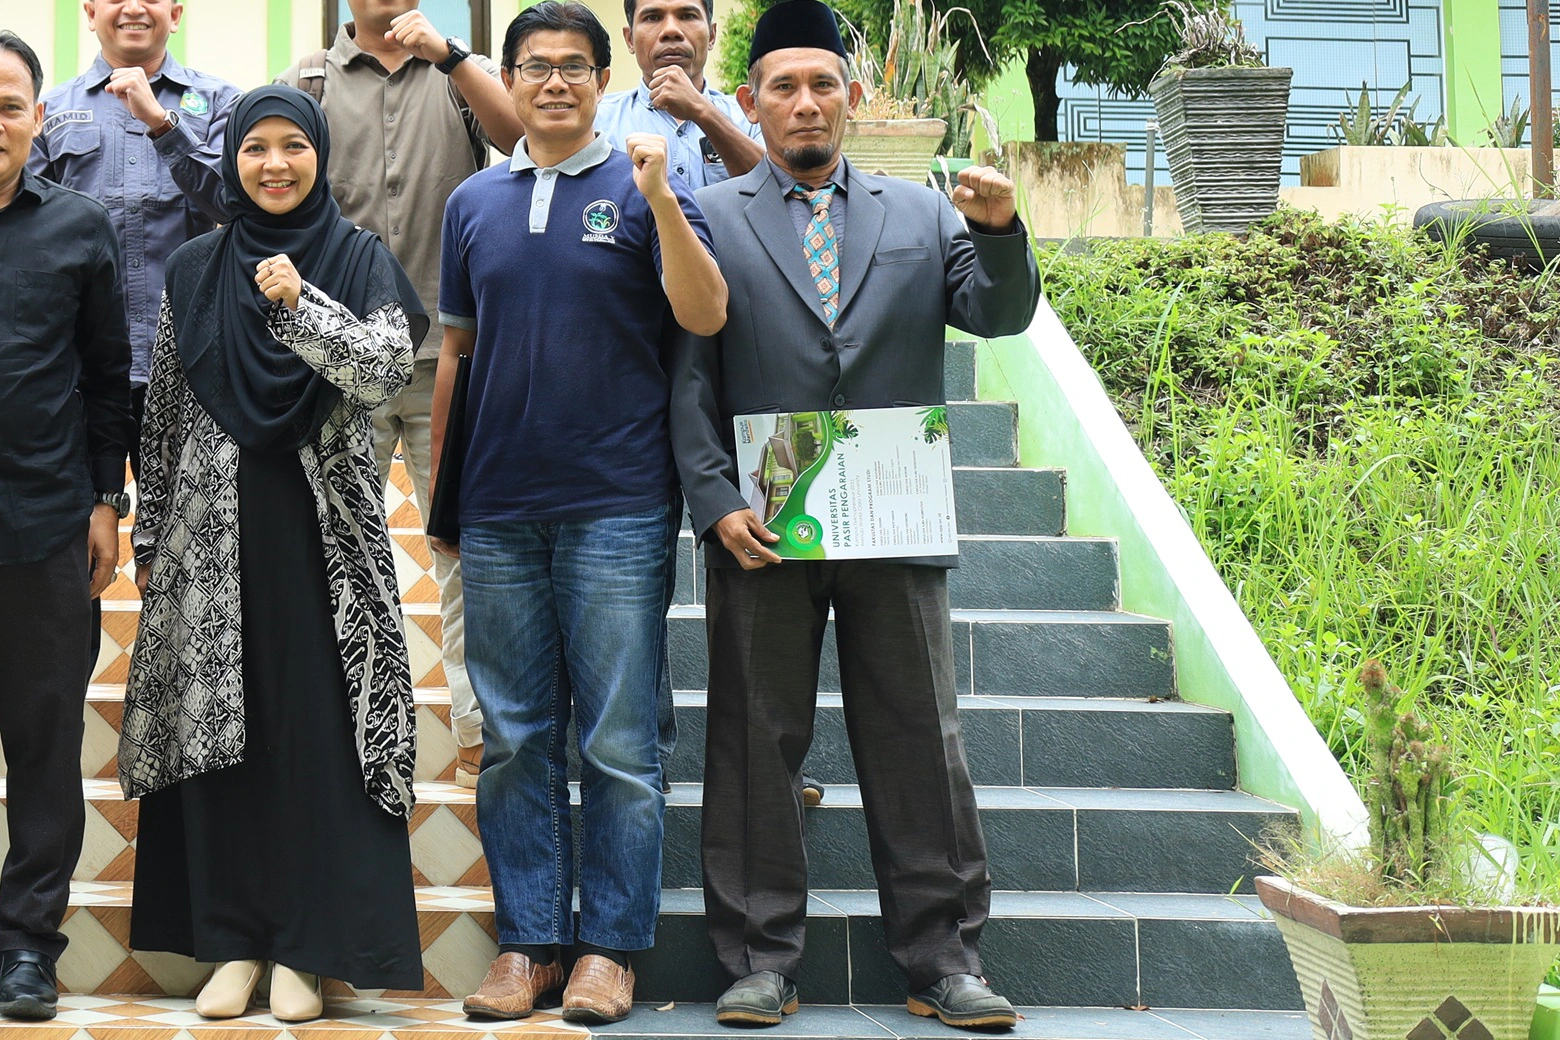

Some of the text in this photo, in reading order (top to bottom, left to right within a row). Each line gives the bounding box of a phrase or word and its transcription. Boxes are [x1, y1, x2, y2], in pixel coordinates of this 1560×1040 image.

[46, 112, 88, 130] HAMID
[829, 488, 840, 547] UNIVERSITAS
[837, 453, 851, 547] PASIR PENGARAIAN
